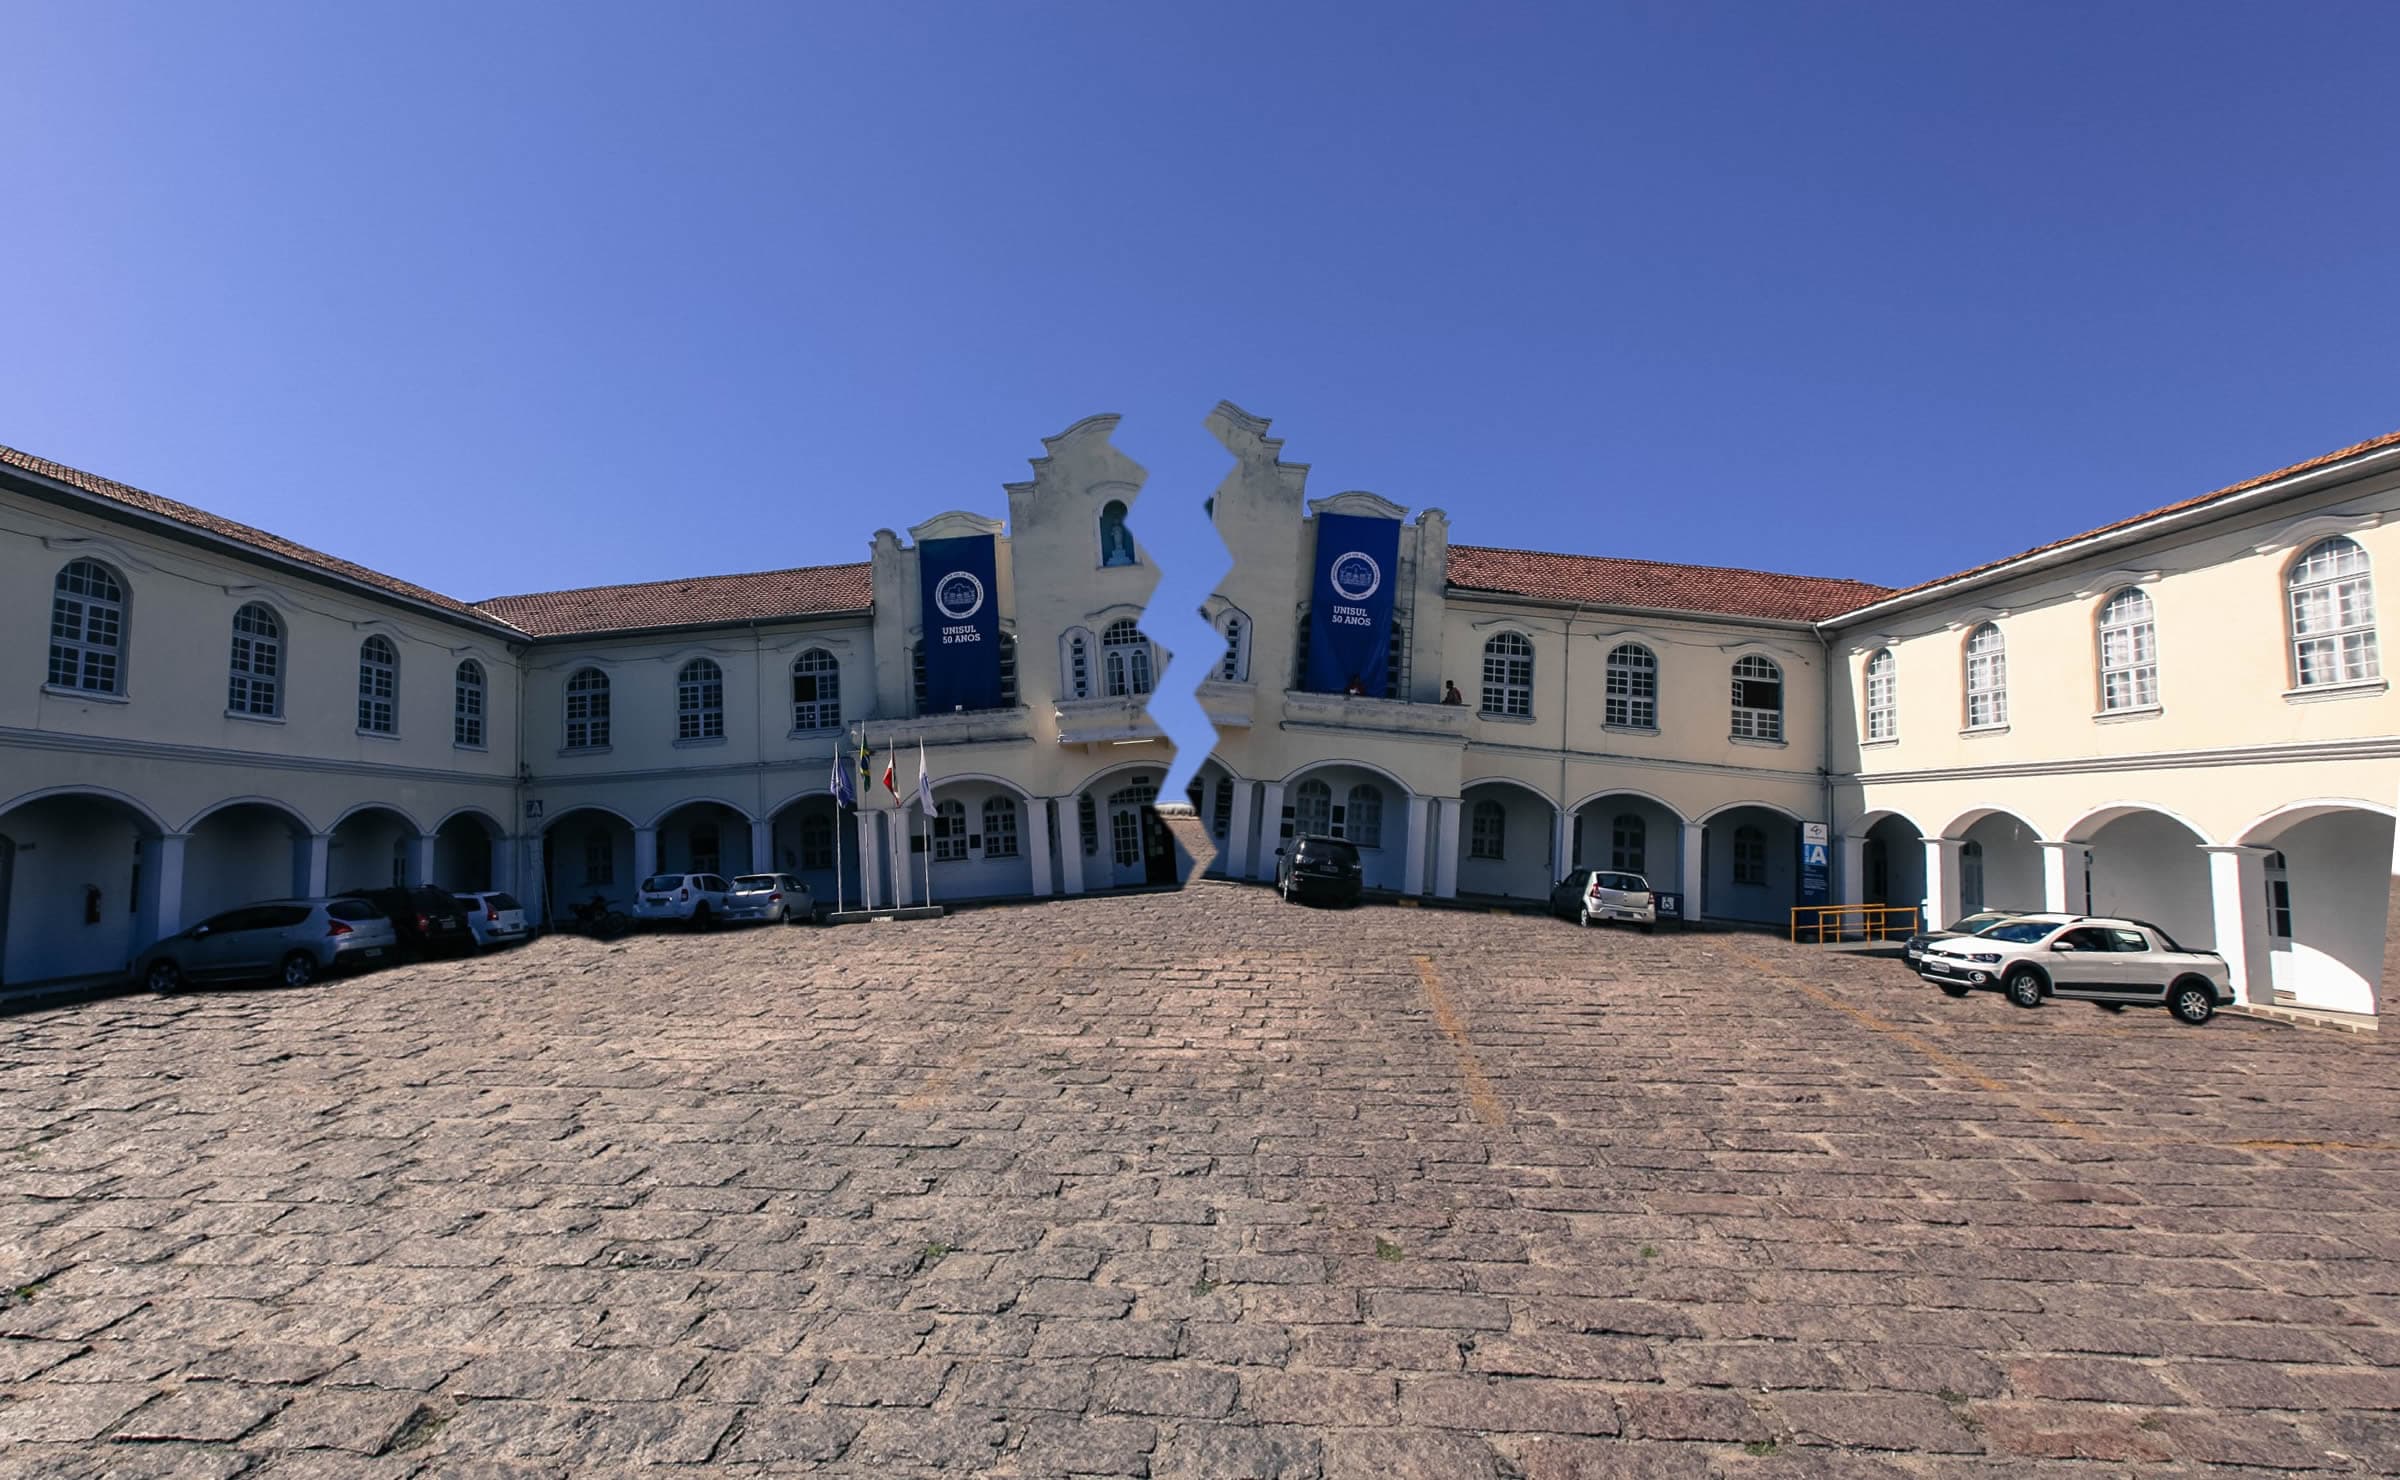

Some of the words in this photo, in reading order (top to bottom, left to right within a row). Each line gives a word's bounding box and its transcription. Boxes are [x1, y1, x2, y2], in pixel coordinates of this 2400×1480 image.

[1333, 605, 1368, 617] UNISUL
[1332, 615, 1343, 623] 50
[1344, 617, 1371, 626] ANOS
[942, 625, 976, 635] UNISUL
[942, 636, 952, 644] 50
[954, 634, 981, 643] ANOS
[531, 801, 542, 816] A
[1810, 846, 1827, 865] A
